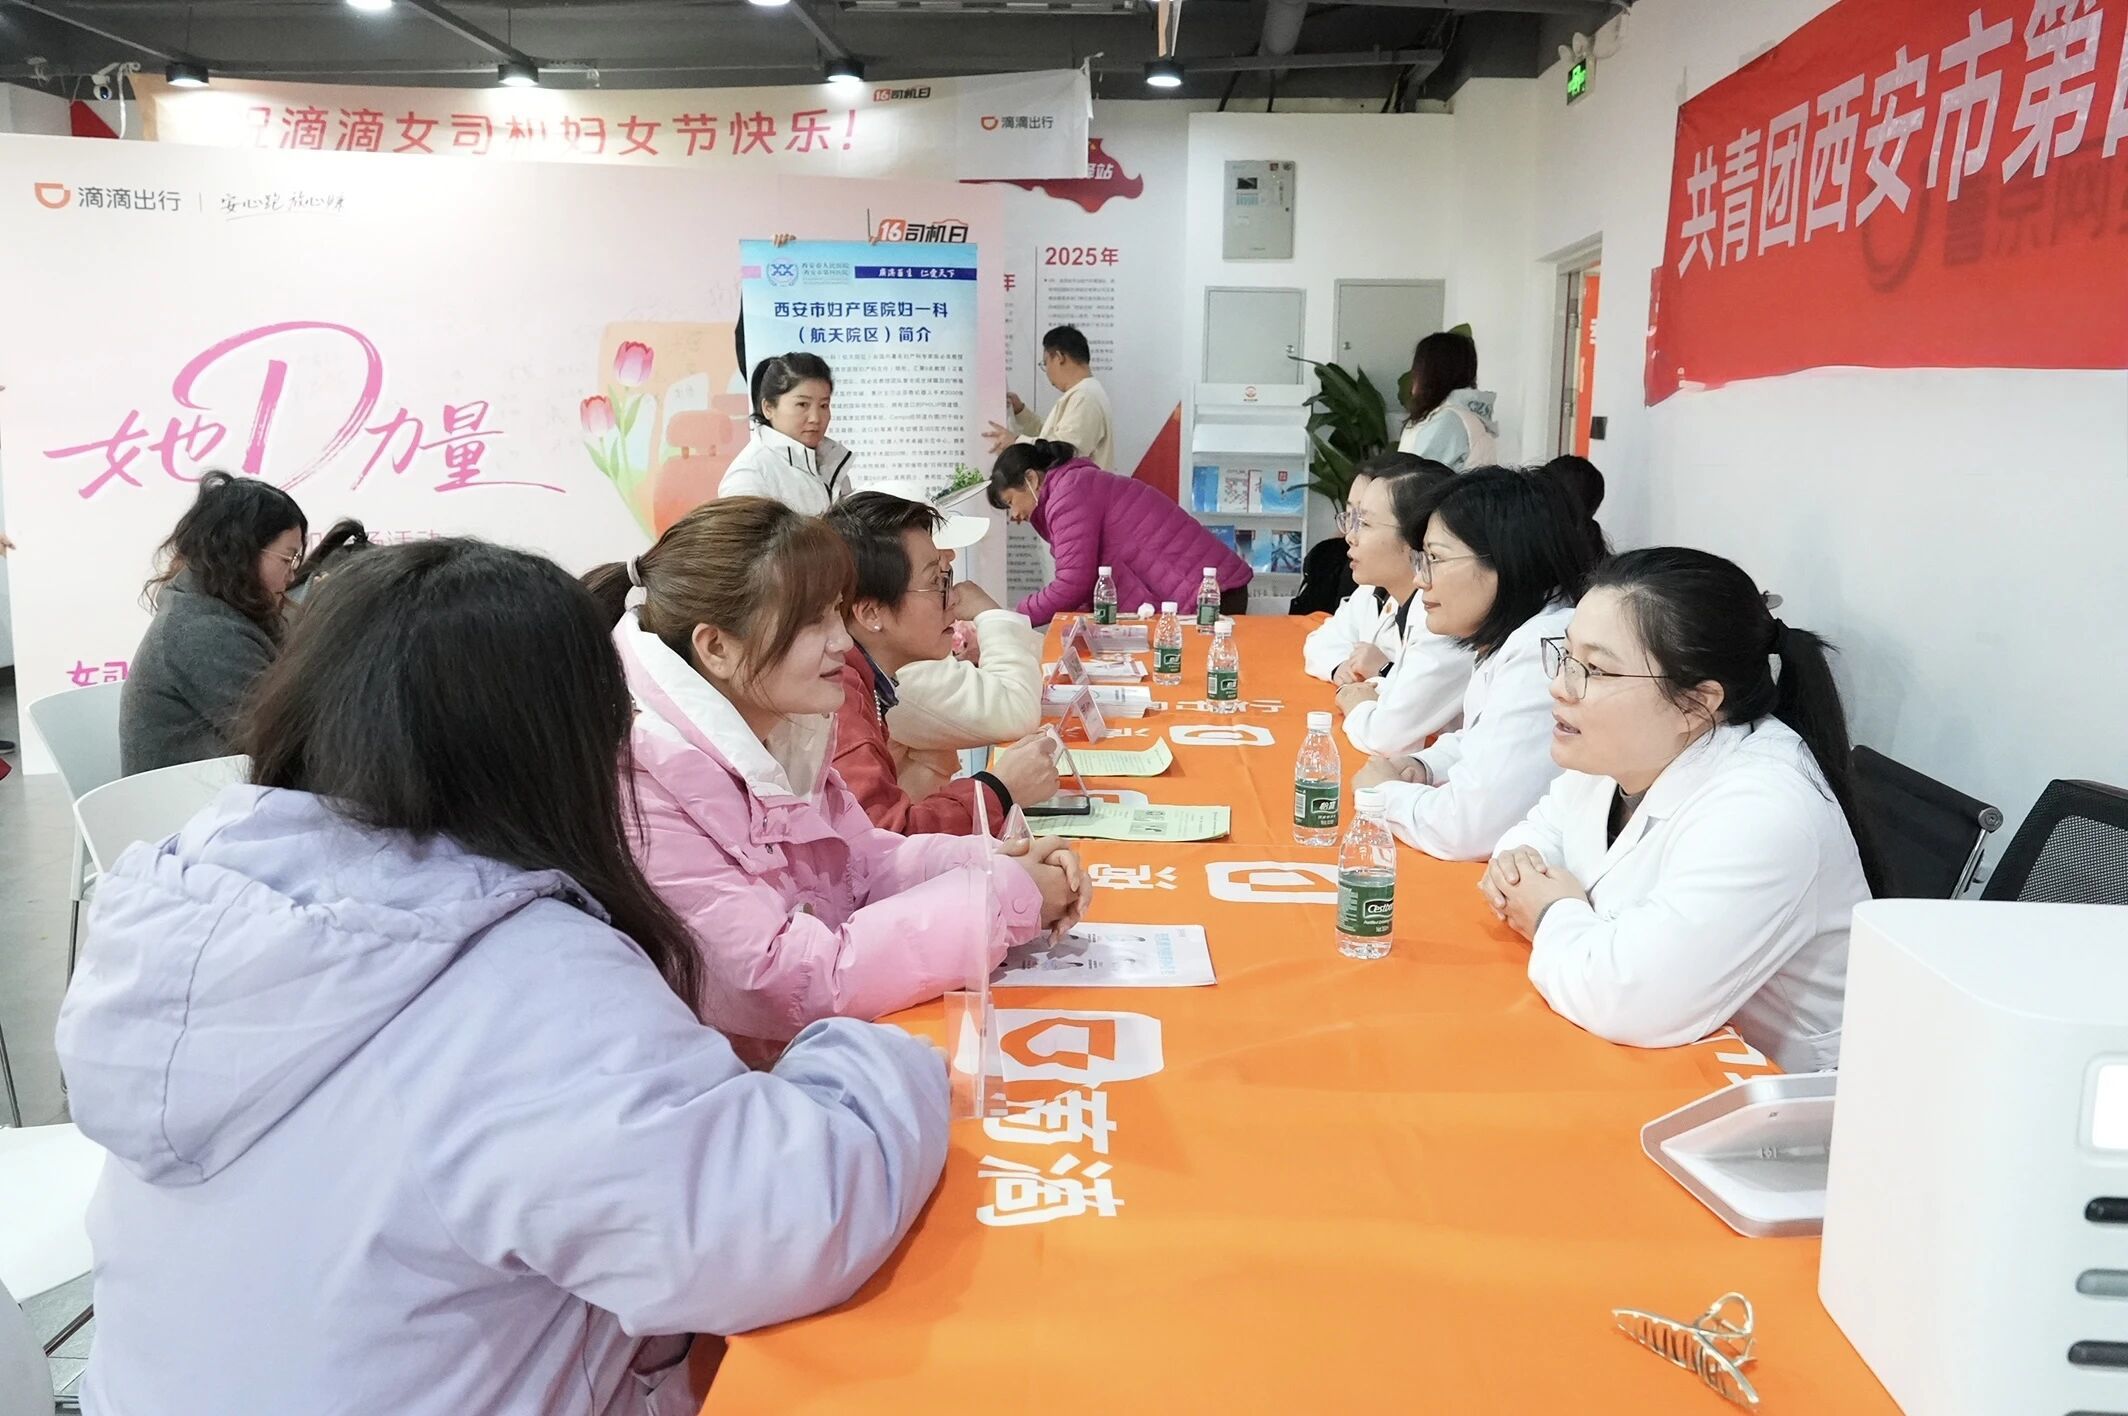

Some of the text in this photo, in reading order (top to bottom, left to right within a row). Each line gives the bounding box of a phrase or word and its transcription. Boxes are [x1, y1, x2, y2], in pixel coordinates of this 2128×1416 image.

[1001, 115, 1053, 129] 滴滴出行
[1678, 0, 2128, 278] 共青团西安市第
[78, 186, 181, 212] 滴滴出行
[879, 220, 968, 244] 16司机日
[1045, 246, 1119, 267] 2025年
[774, 302, 948, 318] 西安市妇产医院妇一科
[799, 327, 931, 343] （航天院区）简介
